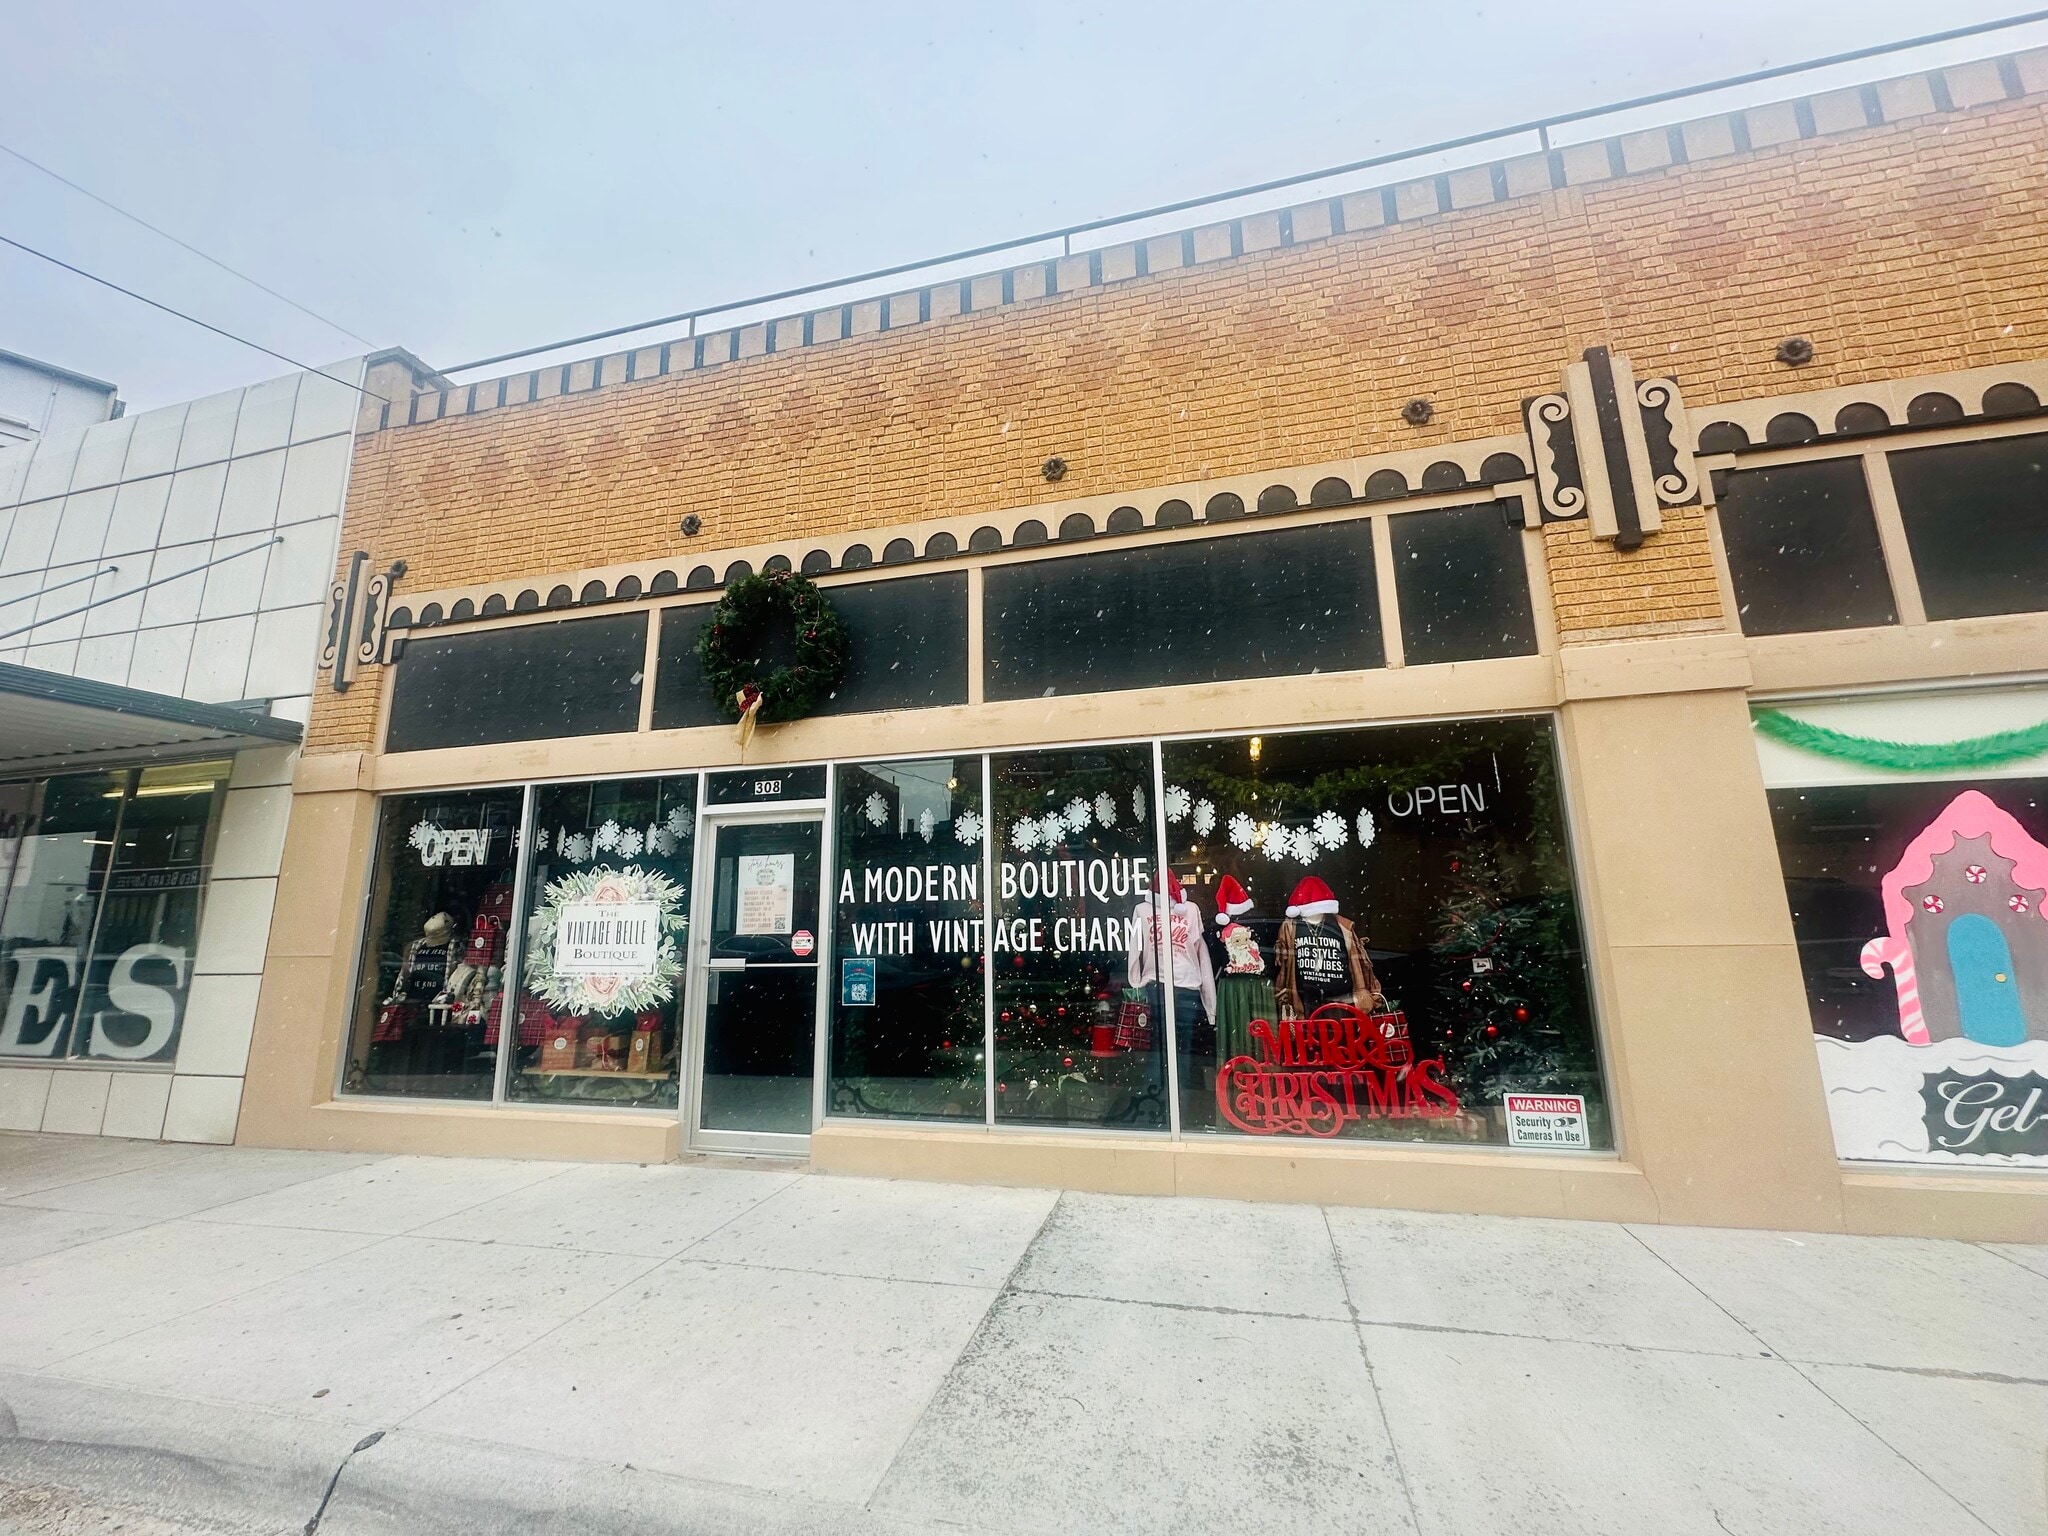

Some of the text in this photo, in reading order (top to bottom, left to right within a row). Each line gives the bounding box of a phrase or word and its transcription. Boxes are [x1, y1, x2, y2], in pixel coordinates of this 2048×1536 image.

[755, 781, 781, 793] 308
[1388, 783, 1485, 817] OPEN
[421, 829, 489, 867] OPEN
[838, 857, 1149, 904] A MODERN BOUTIQUE
[600, 910, 619, 918] THE
[567, 920, 647, 945] VINTAGE BELLE
[851, 921, 913, 956] WITH
[929, 917, 1042, 953] VINTAGE
[1053, 916, 1144, 952] CHARM
[574, 948, 638, 961] BOUTIQUE
[1297, 958, 1316, 969] OOD
[1248, 1002, 1414, 1071] MERRY
[1215, 1054, 1458, 1138] CHRISTMAS
[1512, 1099, 1578, 1112] WARNING
[1515, 1115, 1551, 1130] Security
[1517, 1129, 1580, 1142] Cameras In Use
